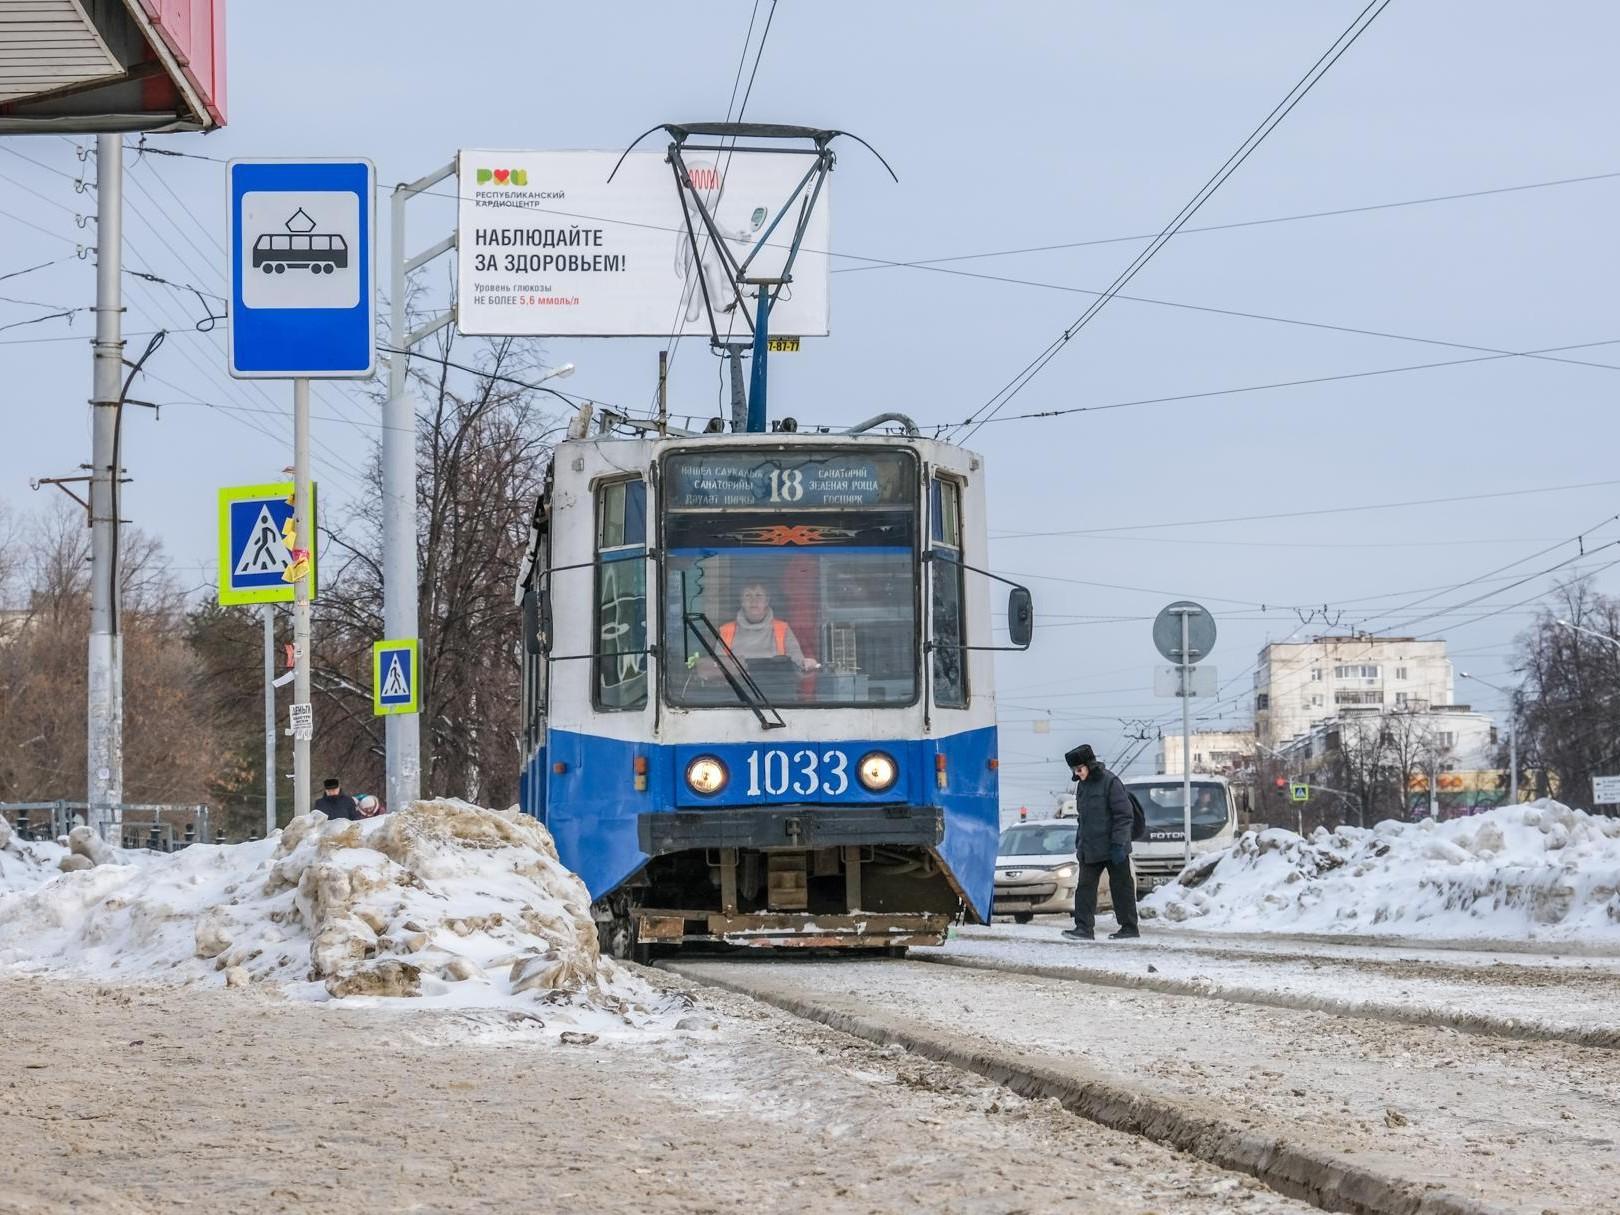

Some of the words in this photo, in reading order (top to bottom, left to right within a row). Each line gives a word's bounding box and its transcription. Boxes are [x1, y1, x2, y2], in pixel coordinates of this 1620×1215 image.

[475, 190, 565, 199] РЕСПУБЛИКАНСКИЙ
[475, 200, 540, 208] КАРДИОЦЕНТР
[475, 225, 603, 248] НАБЛЮДАЙТЕ
[475, 254, 498, 272] ЗА
[504, 254, 626, 274] ЗДОРОВЬЕМ!
[474, 283, 511, 292] Уровень
[513, 283, 552, 292] глюкозы
[474, 296, 486, 305] НЕ
[488, 296, 517, 305] БОЛЕЕ
[519, 296, 536, 306] 5,6
[537, 296, 580, 305] ммоль/л
[818, 467, 867, 478] САНАТОРИЙ
[769, 469, 804, 502] 18
[852, 480, 878, 491] РОЩА
[747, 750, 848, 796] 1033
